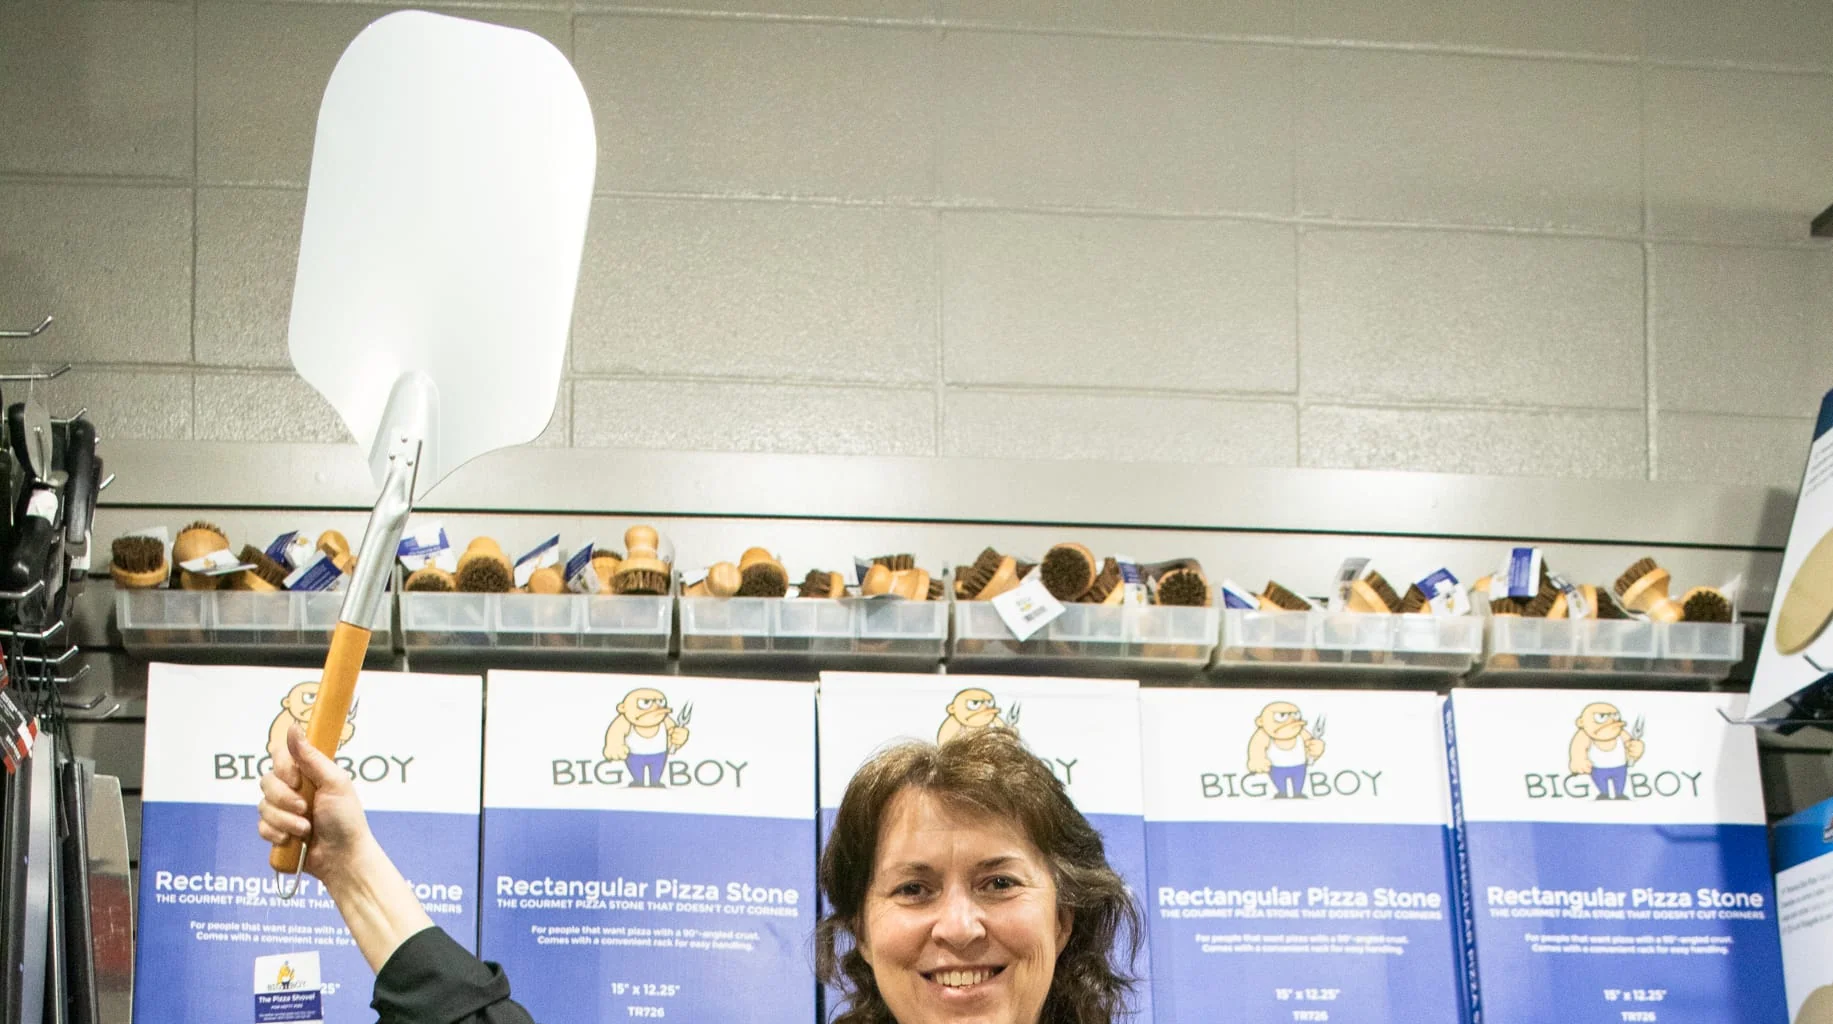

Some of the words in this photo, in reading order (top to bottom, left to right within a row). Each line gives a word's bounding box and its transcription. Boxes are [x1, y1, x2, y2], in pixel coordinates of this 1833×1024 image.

[551, 759, 624, 786] BIG
[668, 760, 748, 788] BOY
[1201, 772, 1268, 798] BIG
[1308, 769, 1383, 797] BOY
[1524, 772, 1589, 799] BIG
[1629, 770, 1702, 798] BOY
[155, 870, 309, 896] Rectangular
[407, 880, 463, 901] one
[496, 875, 648, 900] Rectangular
[655, 879, 719, 901] Pizza
[726, 882, 799, 905] Stone
[156, 893, 176, 904] THE
[178, 893, 234, 905] GOURMET
[235, 895, 268, 907] PIZZA
[269, 896, 307, 908] STONE
[308, 898, 335, 909] THAT
[1158, 886, 1302, 910] Rectangular
[1307, 886, 1368, 907] Pizza
[1373, 887, 1441, 908] Stone
[1487, 885, 1627, 911] Rectangular
[1631, 887, 1692, 908] Pizza
[1696, 888, 1764, 908] Stone
[497, 898, 517, 908] THE
[519, 898, 573, 909] GOURMET
[575, 899, 607, 910] PIZZA
[608, 900, 644, 911] STONE
[647, 901, 674, 912] THAT
[676, 902, 721, 913] DOESN'T
[723, 904, 745, 915] CUT
[747, 905, 799, 917] CORNERS
[190, 920, 206, 930] For
[207, 921, 239, 932] people
[241, 922, 260, 932] that
[262, 924, 286, 934] want
[288, 924, 312, 935] pizza
[314, 926, 336, 936] with
[196, 931, 229, 942] Comes
[230, 932, 252, 942] with
[261, 934, 313, 945] convenient
[314, 936, 334, 946] rack
[336, 936, 349, 946] for
[611, 982, 630, 995] 15"
[632, 985, 640, 996] x
[643, 983, 681, 997] 12.25"
[1295, 990, 1304, 1001] x
[1623, 991, 1632, 1001] x
[258, 996, 272, 1004] The
[627, 1006, 665, 1018] TR726
